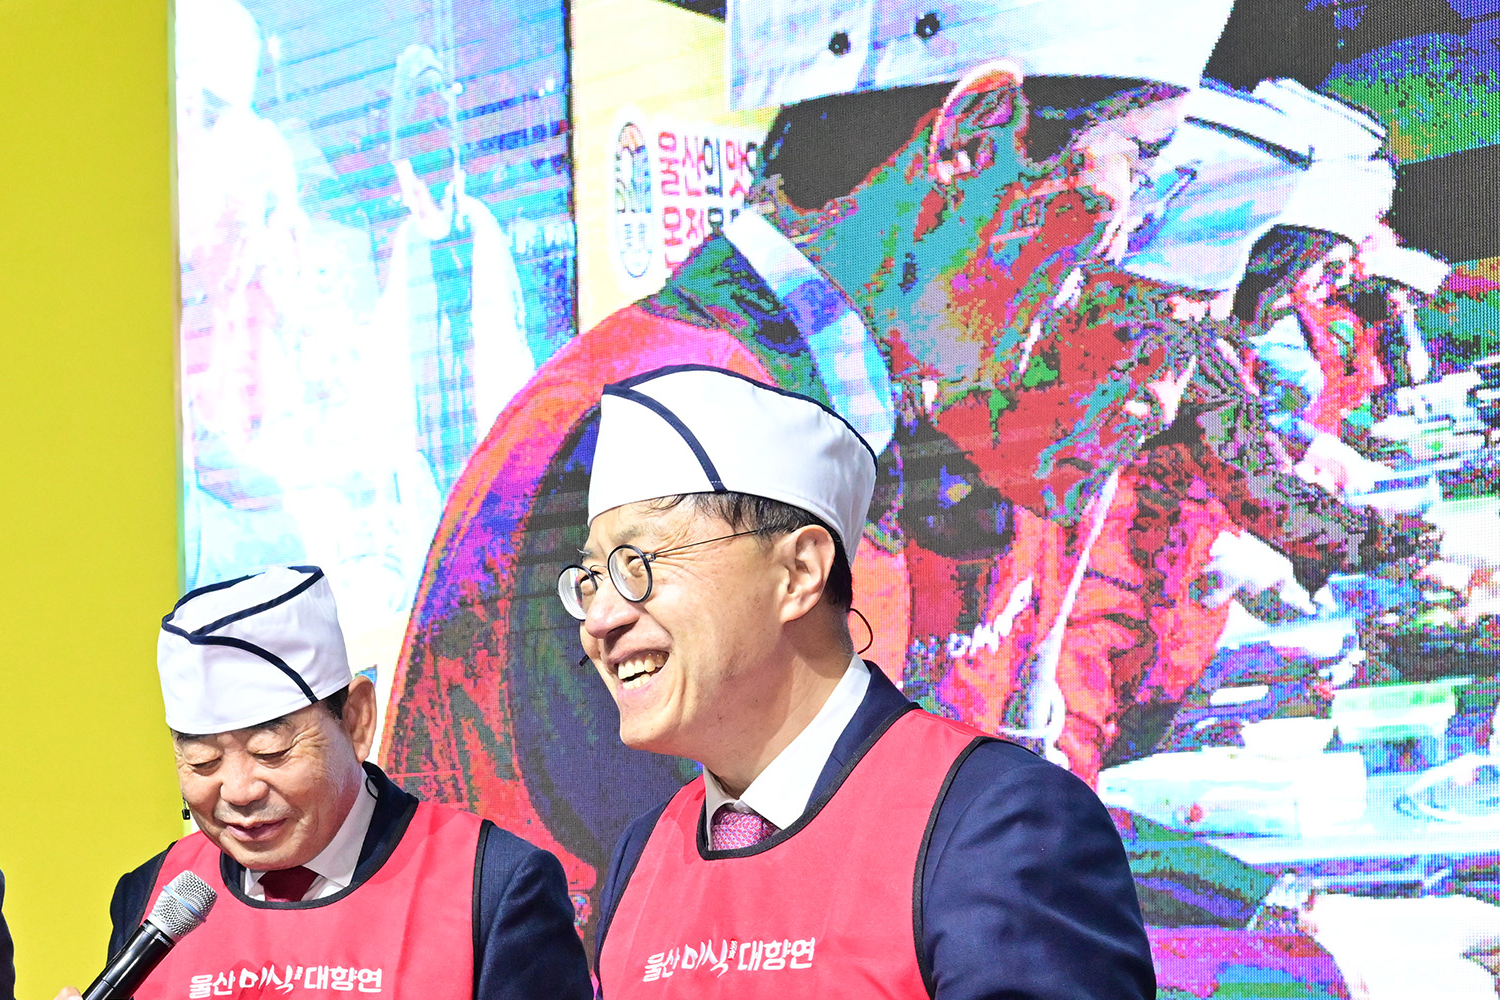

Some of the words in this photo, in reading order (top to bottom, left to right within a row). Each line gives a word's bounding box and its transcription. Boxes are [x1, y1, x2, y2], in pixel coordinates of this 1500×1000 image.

[642, 947, 681, 982] 울산
[681, 939, 729, 978] 미식
[737, 937, 816, 971] 대향연
[189, 970, 236, 999] 울산
[238, 964, 295, 995] 미식
[303, 965, 383, 993] 대향연
